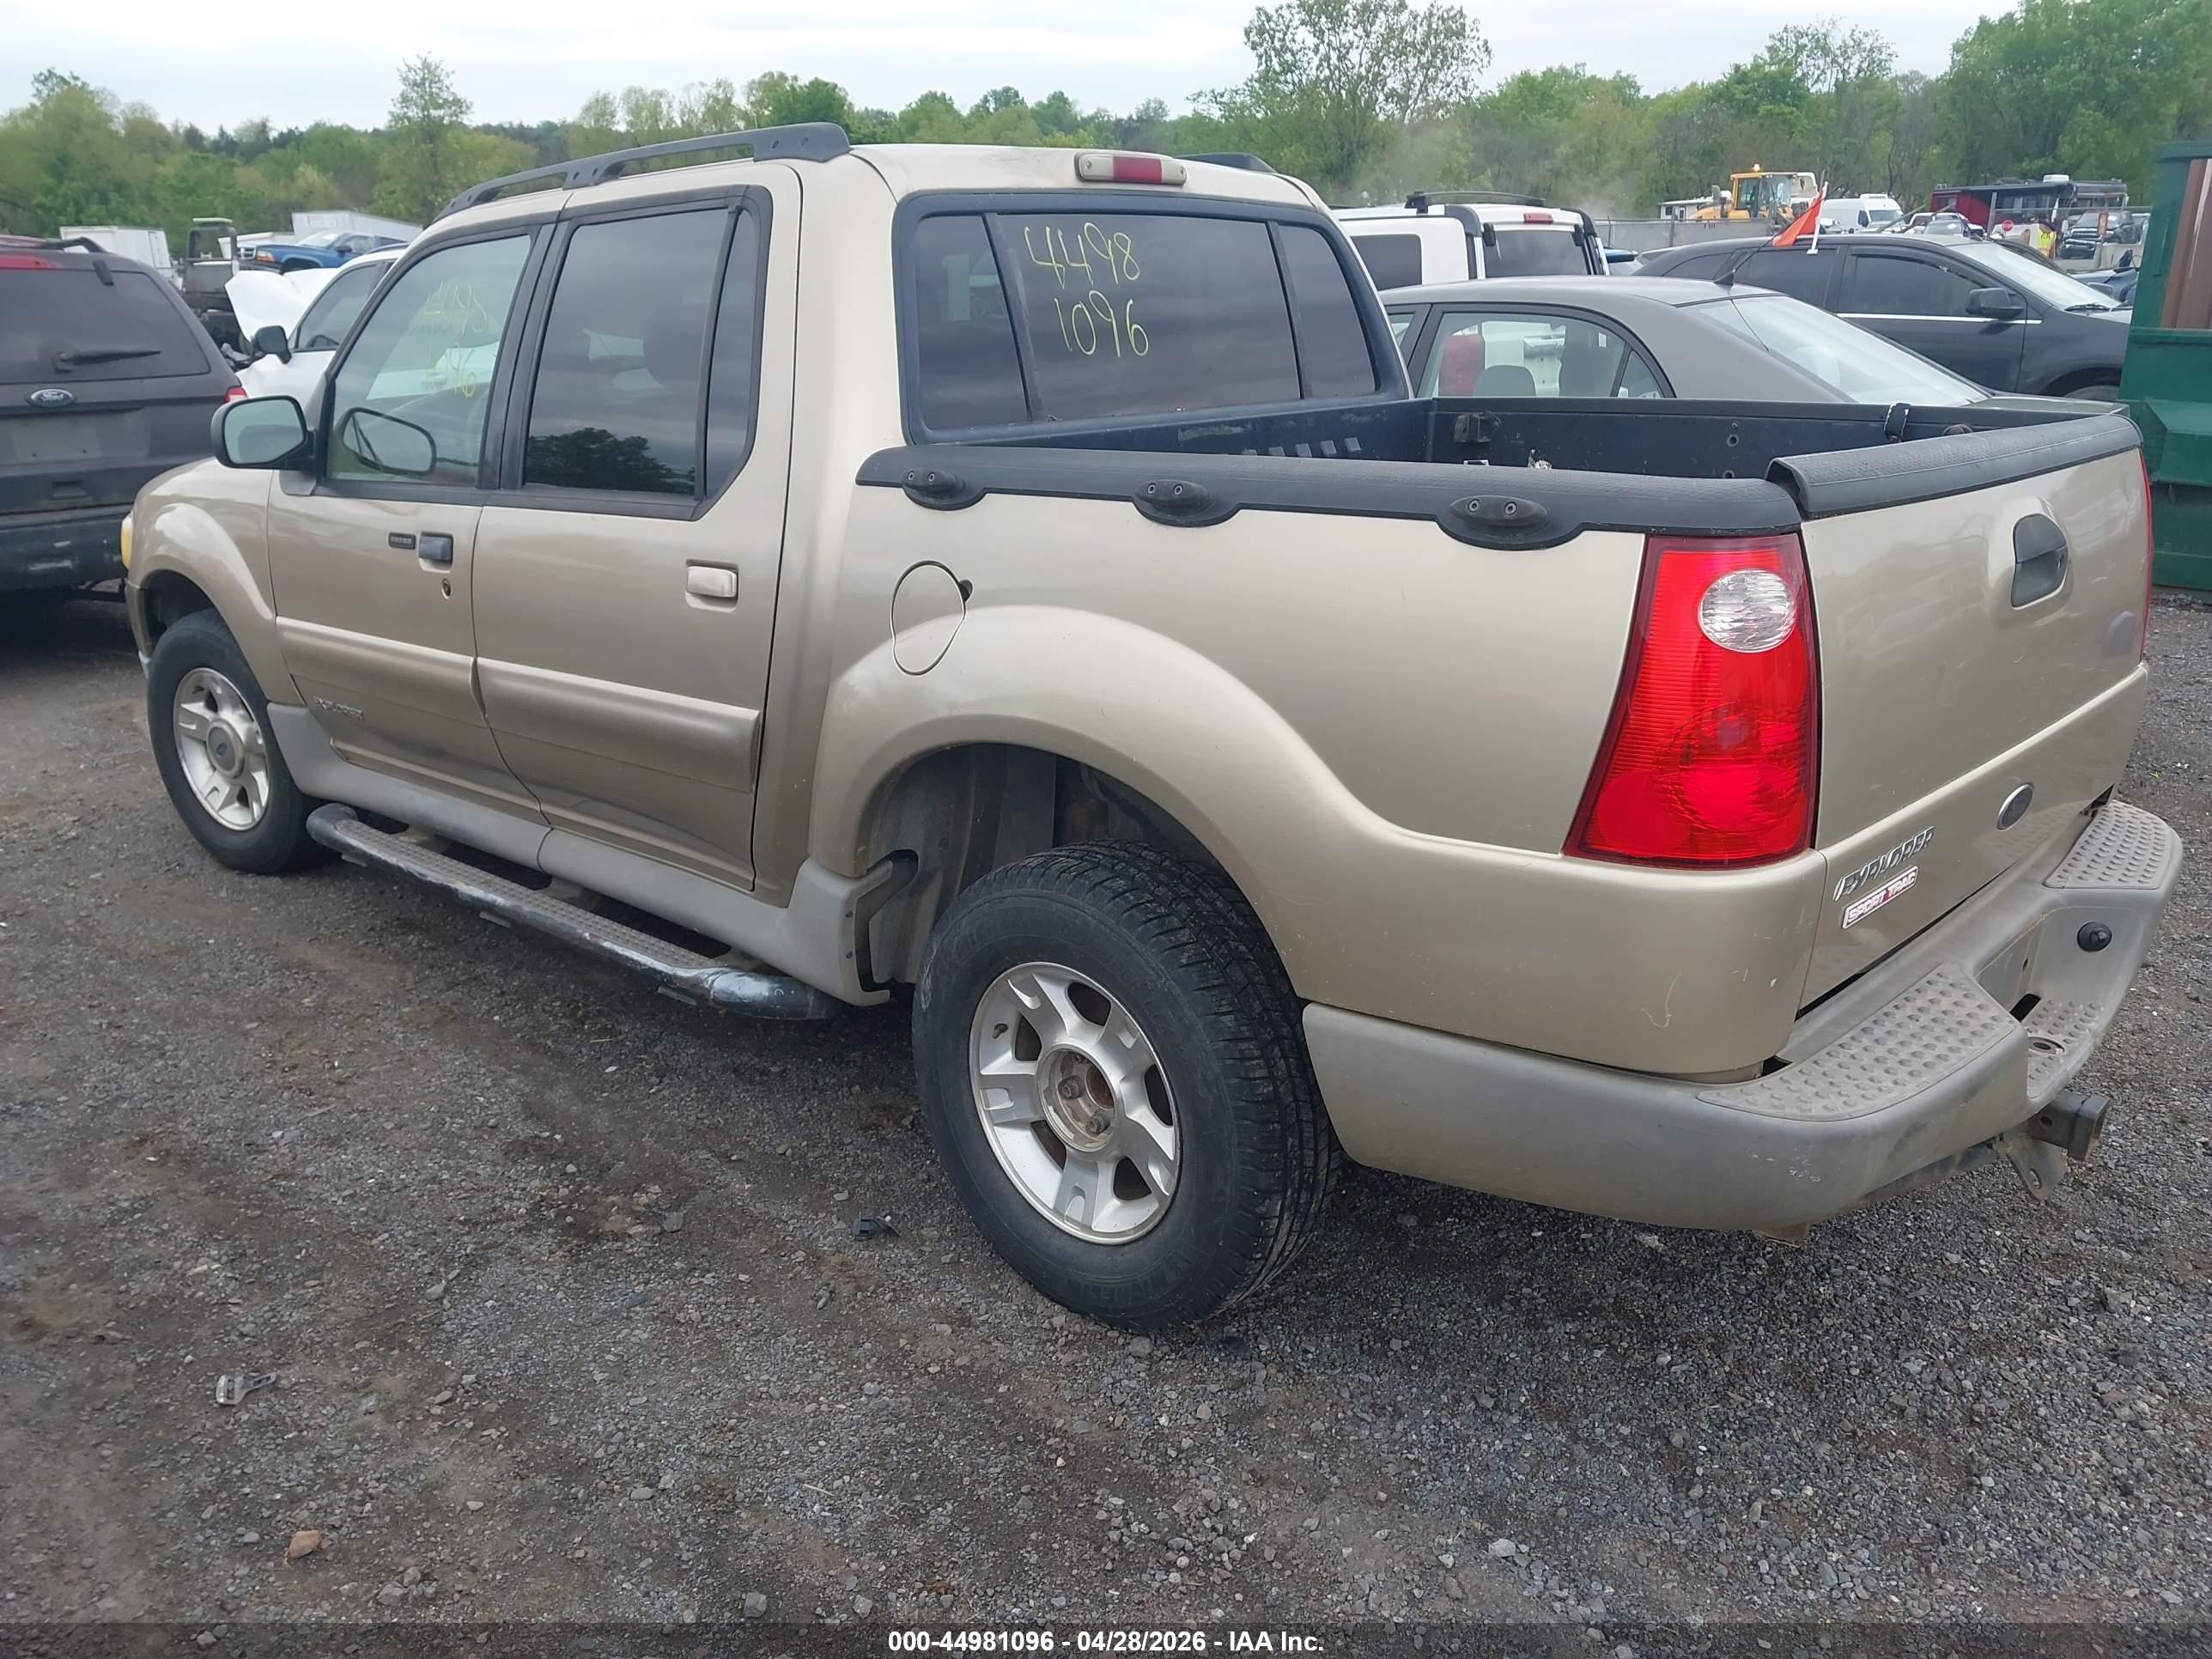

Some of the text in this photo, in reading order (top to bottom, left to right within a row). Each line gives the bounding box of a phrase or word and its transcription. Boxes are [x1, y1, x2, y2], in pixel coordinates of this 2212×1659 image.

[1024, 222, 1140, 289] 4498
[1054, 289, 1149, 358] 1096
[1847, 871, 1917, 921] SPORT TRAC
